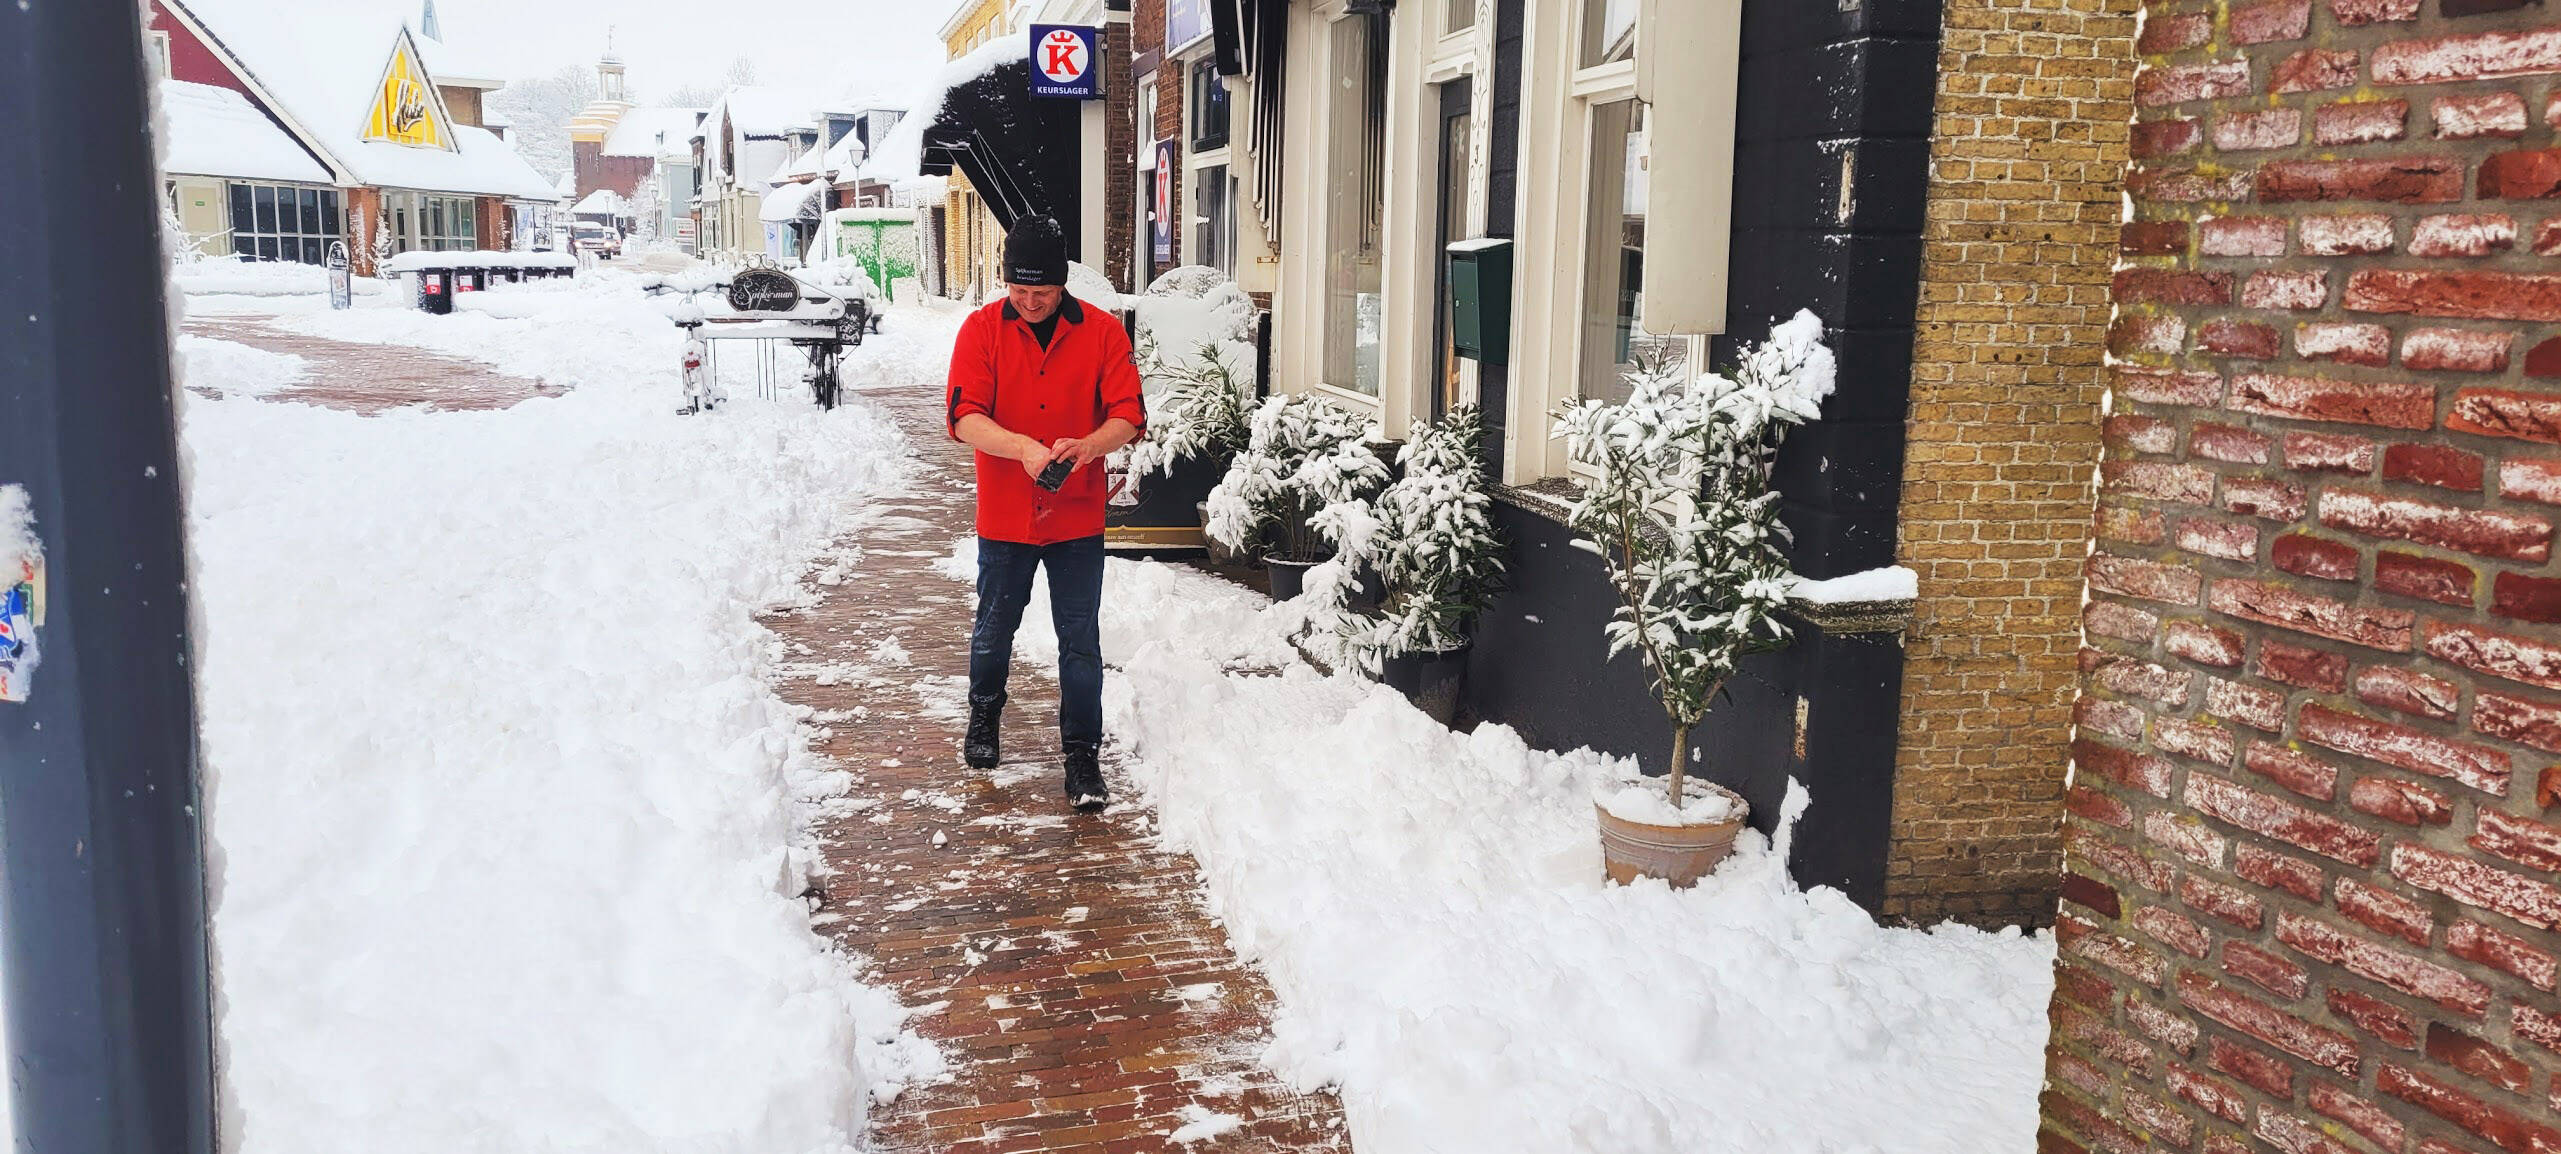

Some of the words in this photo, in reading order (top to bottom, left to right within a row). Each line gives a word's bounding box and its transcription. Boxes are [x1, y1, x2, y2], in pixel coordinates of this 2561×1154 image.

[1045, 44, 1079, 76] K
[1037, 86, 1089, 95] KEURSLAGER
[1158, 172, 1168, 223] K
